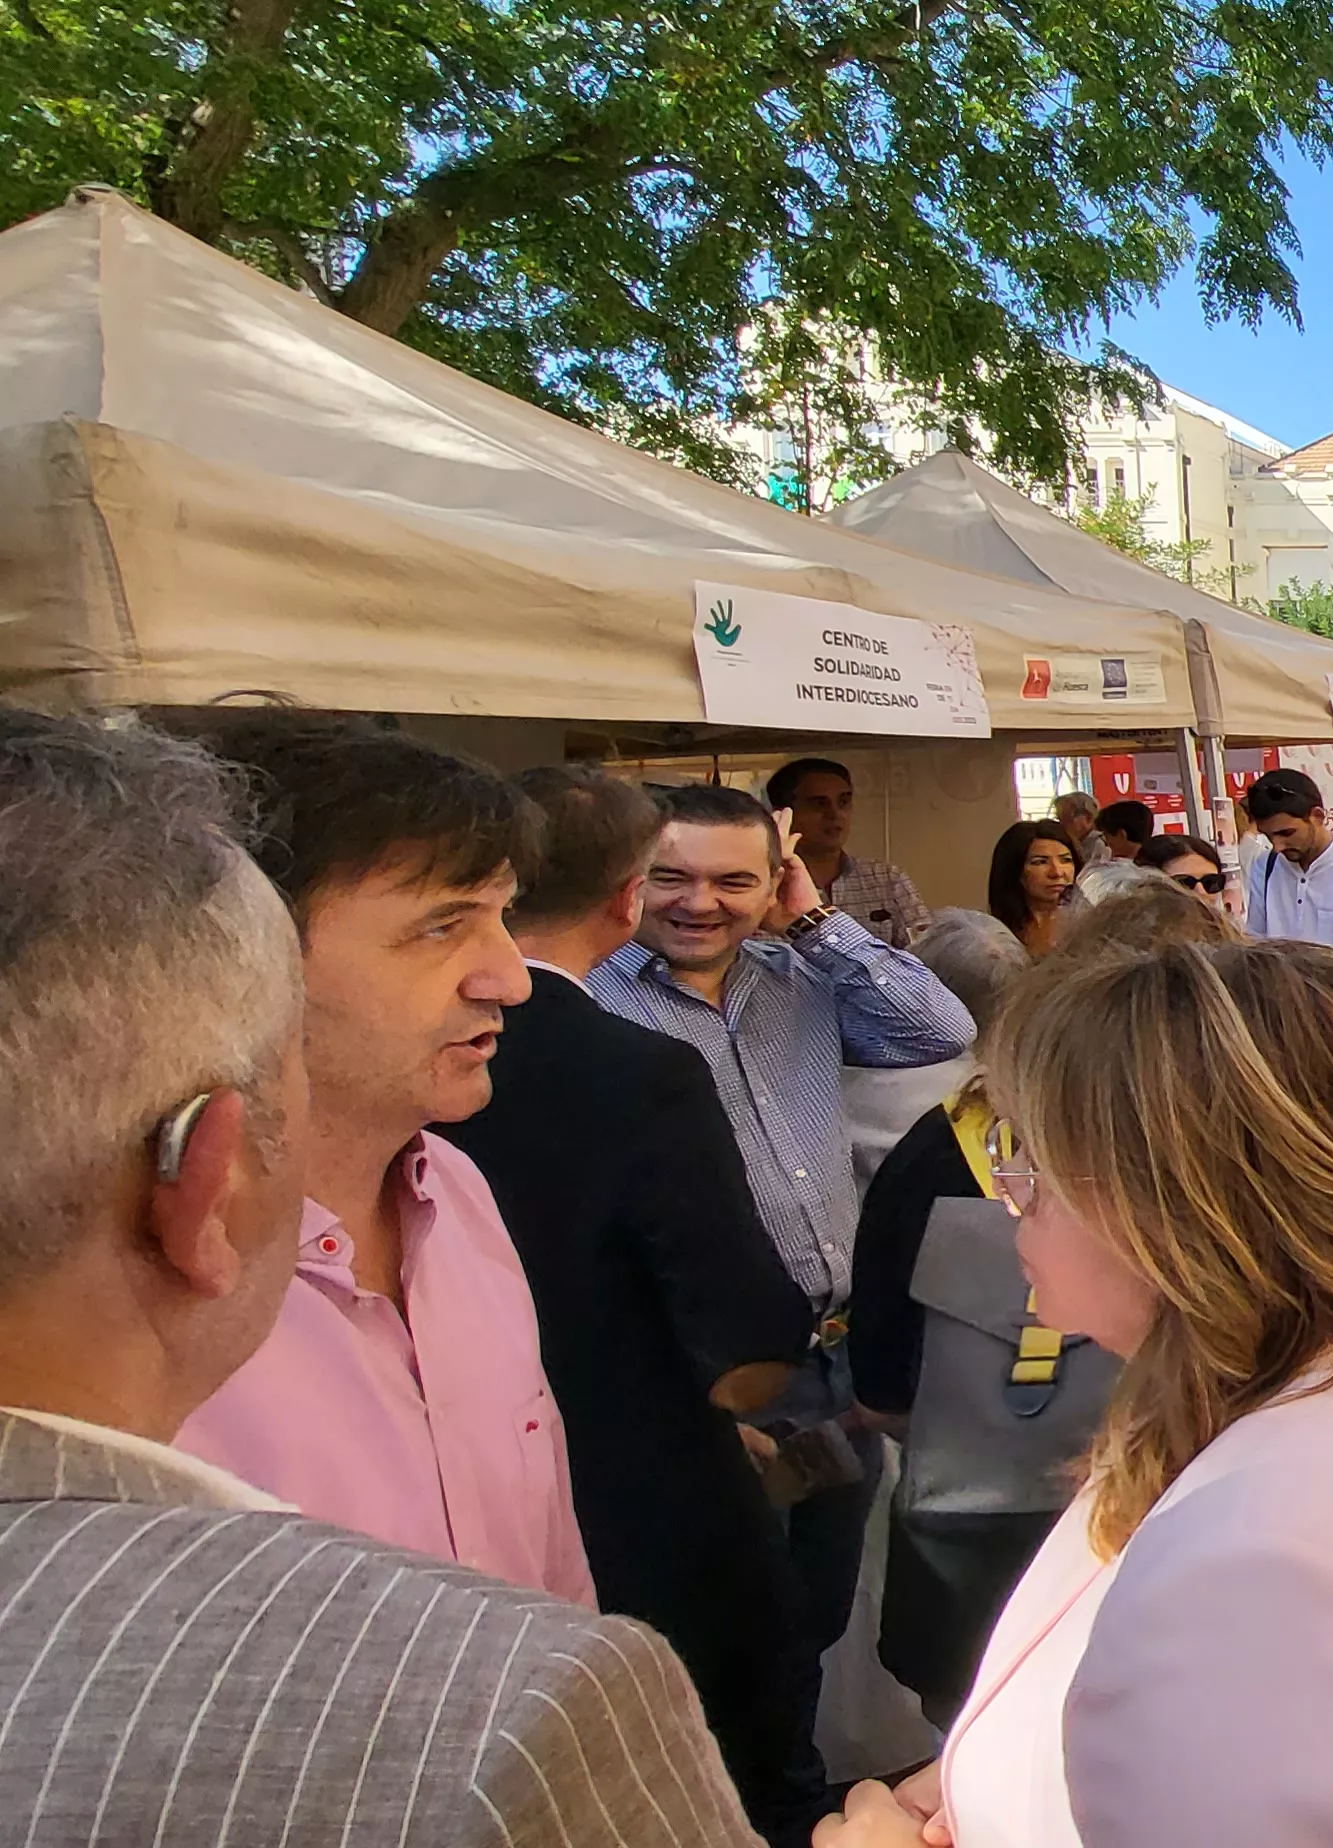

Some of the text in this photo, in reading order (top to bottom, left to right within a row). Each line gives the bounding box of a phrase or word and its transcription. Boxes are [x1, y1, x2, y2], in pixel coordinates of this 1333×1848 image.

[822, 630, 889, 655] CENTRO DE
[813, 657, 901, 682] SOLIDARIDAD
[796, 684, 919, 709] INTERDIOCESANO
